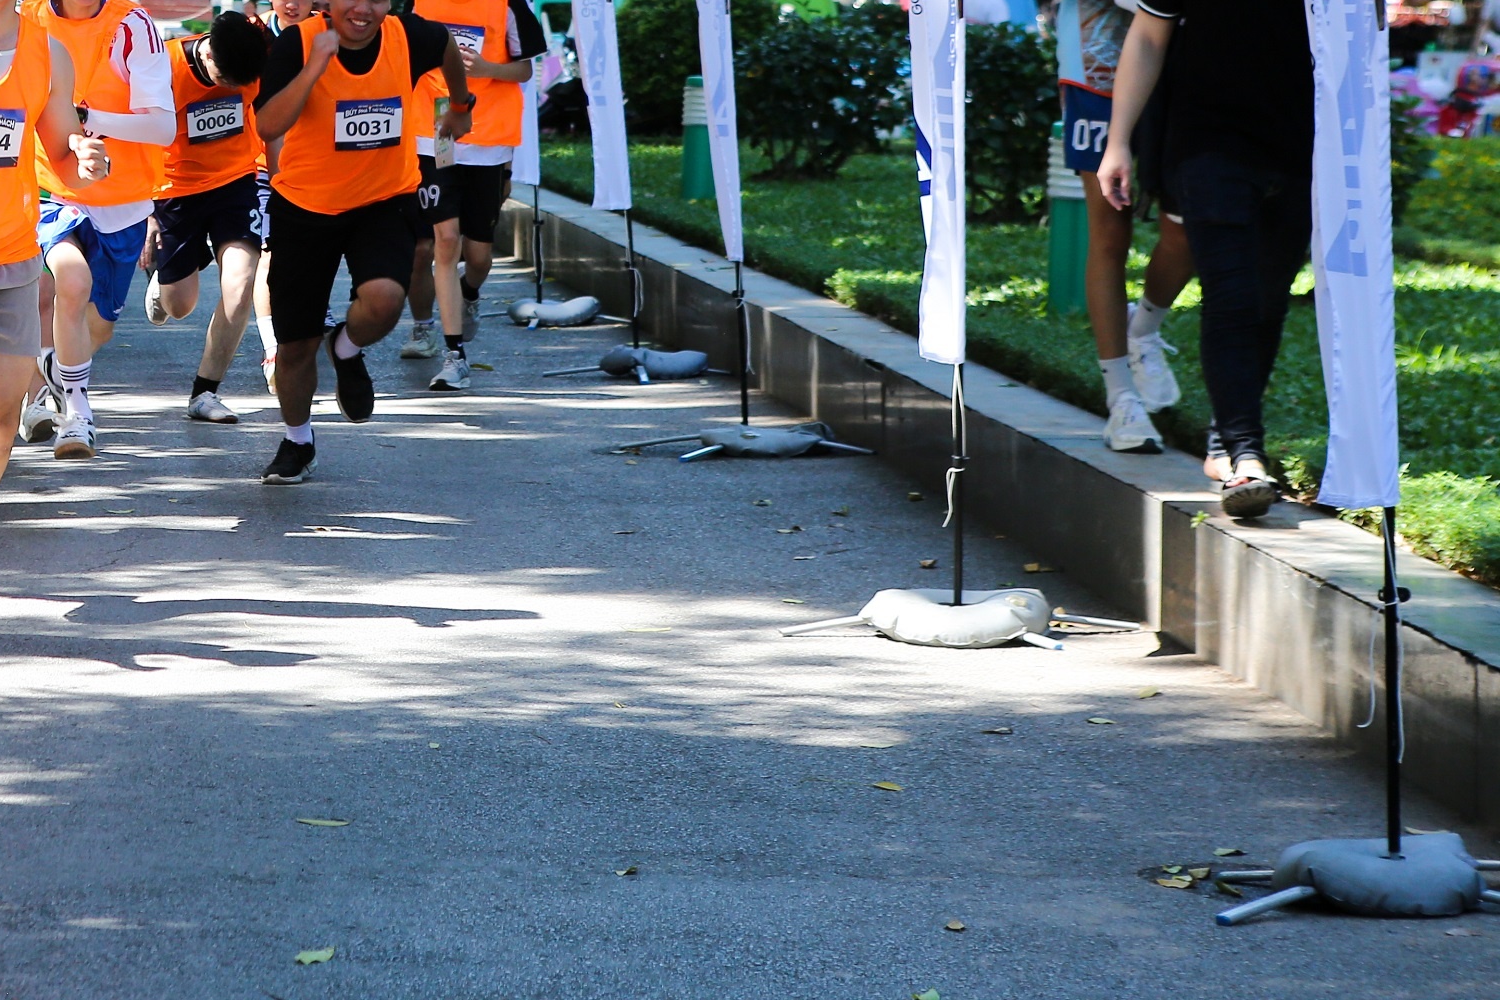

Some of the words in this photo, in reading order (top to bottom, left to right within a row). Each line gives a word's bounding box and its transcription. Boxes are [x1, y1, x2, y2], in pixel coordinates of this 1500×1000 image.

[196, 112, 236, 132] 0006
[345, 119, 391, 137] 0031
[1072, 119, 1109, 152] 07
[418, 184, 441, 210] 09
